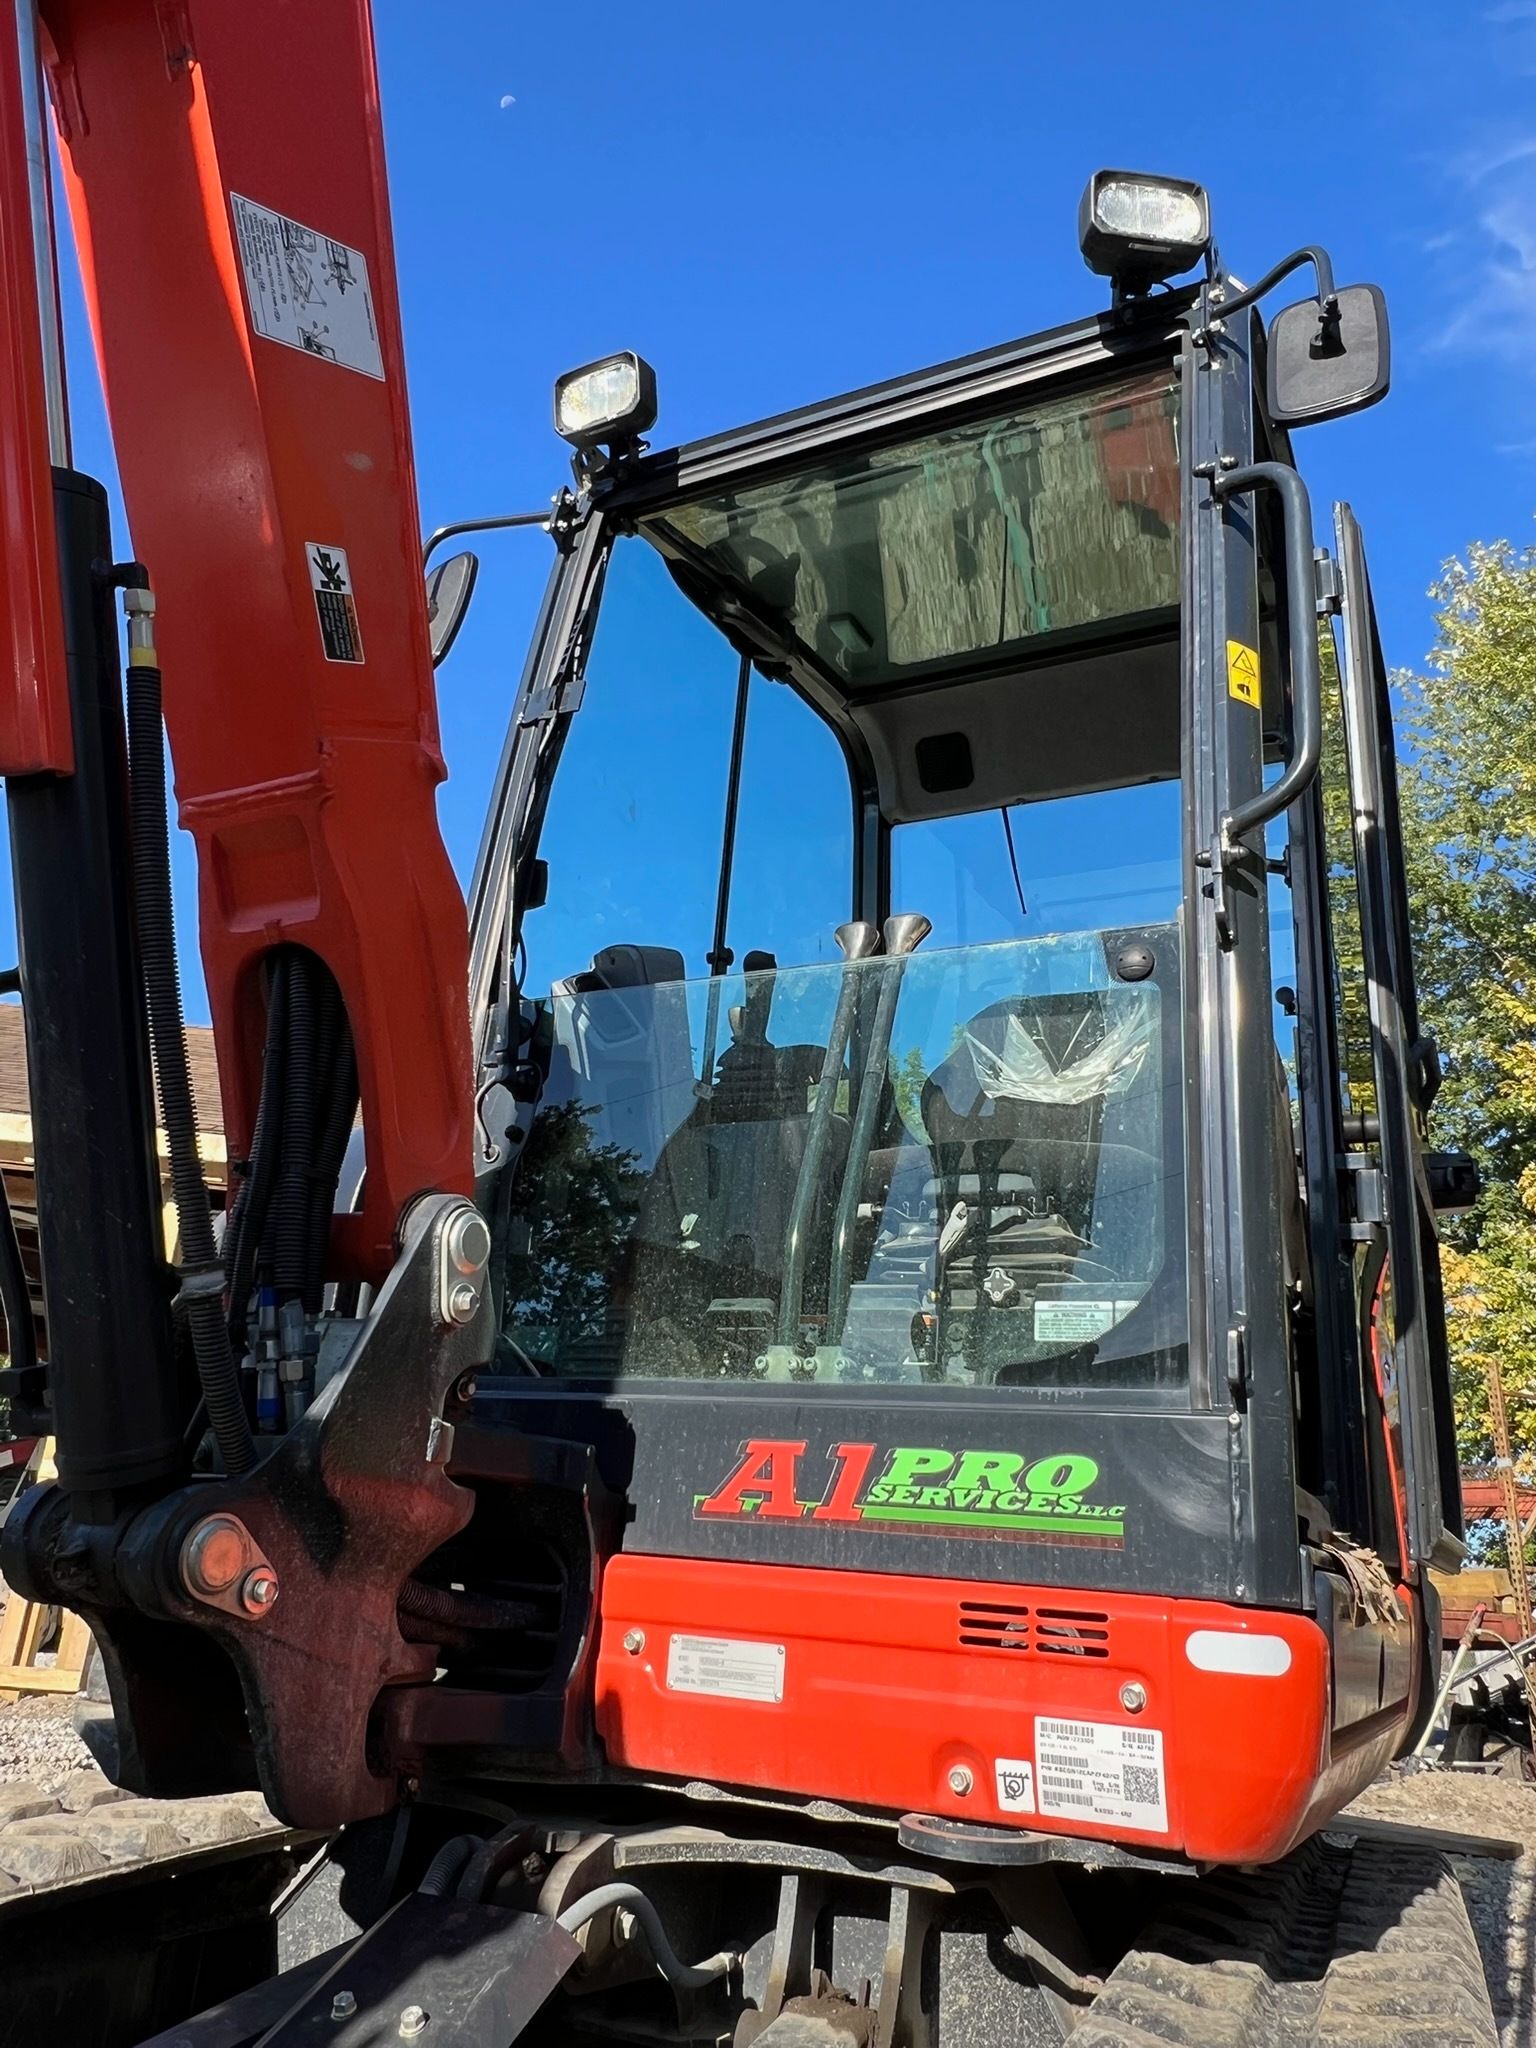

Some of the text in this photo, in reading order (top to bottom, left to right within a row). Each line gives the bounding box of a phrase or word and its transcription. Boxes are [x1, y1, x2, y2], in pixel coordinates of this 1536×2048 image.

[882, 1447, 1100, 1494] PRO
[865, 1483, 1127, 1518] SERVICES LLC
